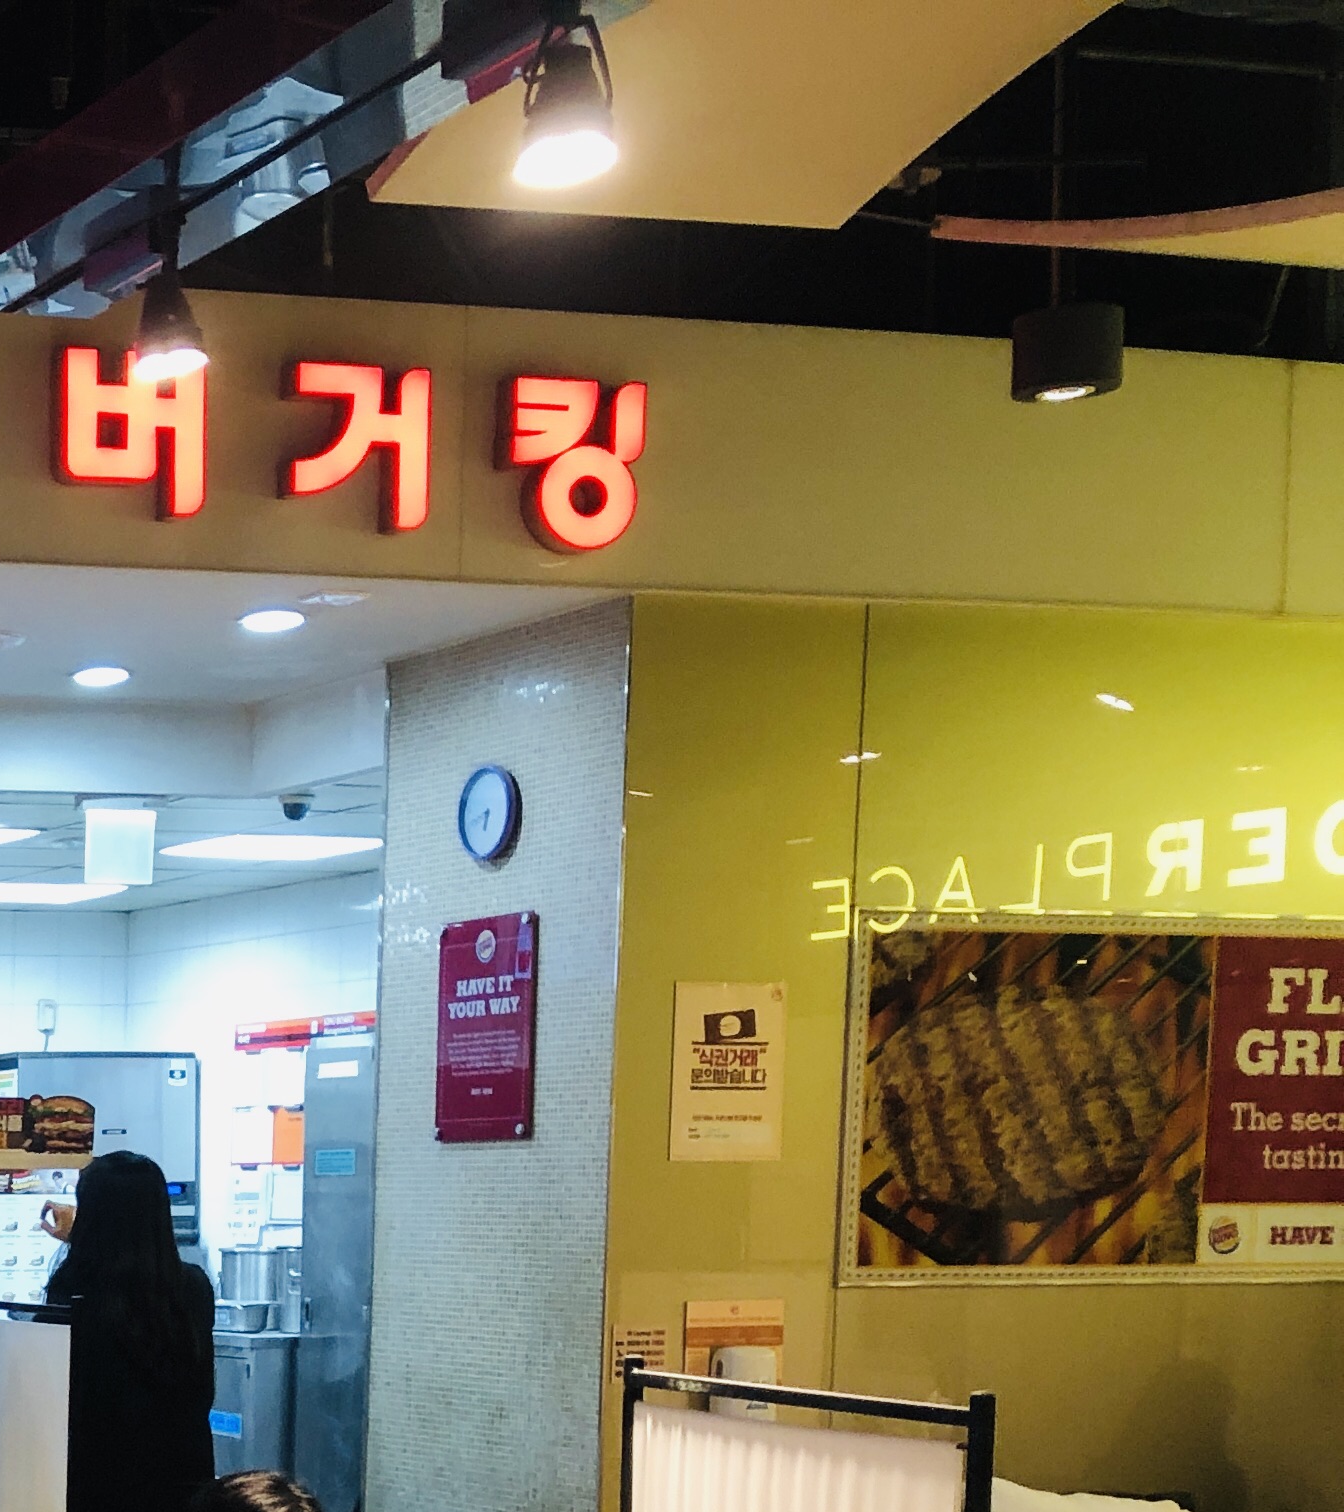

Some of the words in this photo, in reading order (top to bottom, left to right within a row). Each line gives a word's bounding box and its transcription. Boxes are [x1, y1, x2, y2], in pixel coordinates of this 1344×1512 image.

[60, 345, 649, 552] 버거킹
[455, 976, 496, 997] HAVE
[498, 974, 515, 993] IT
[1266, 967, 1344, 1015] FL
[447, 999, 487, 1020] YOUR
[1235, 1027, 1344, 1078] GRI
[1230, 1101, 1284, 1133] The
[1262, 1142, 1344, 1170] tastin
[1269, 1225, 1335, 1245] HAVE
